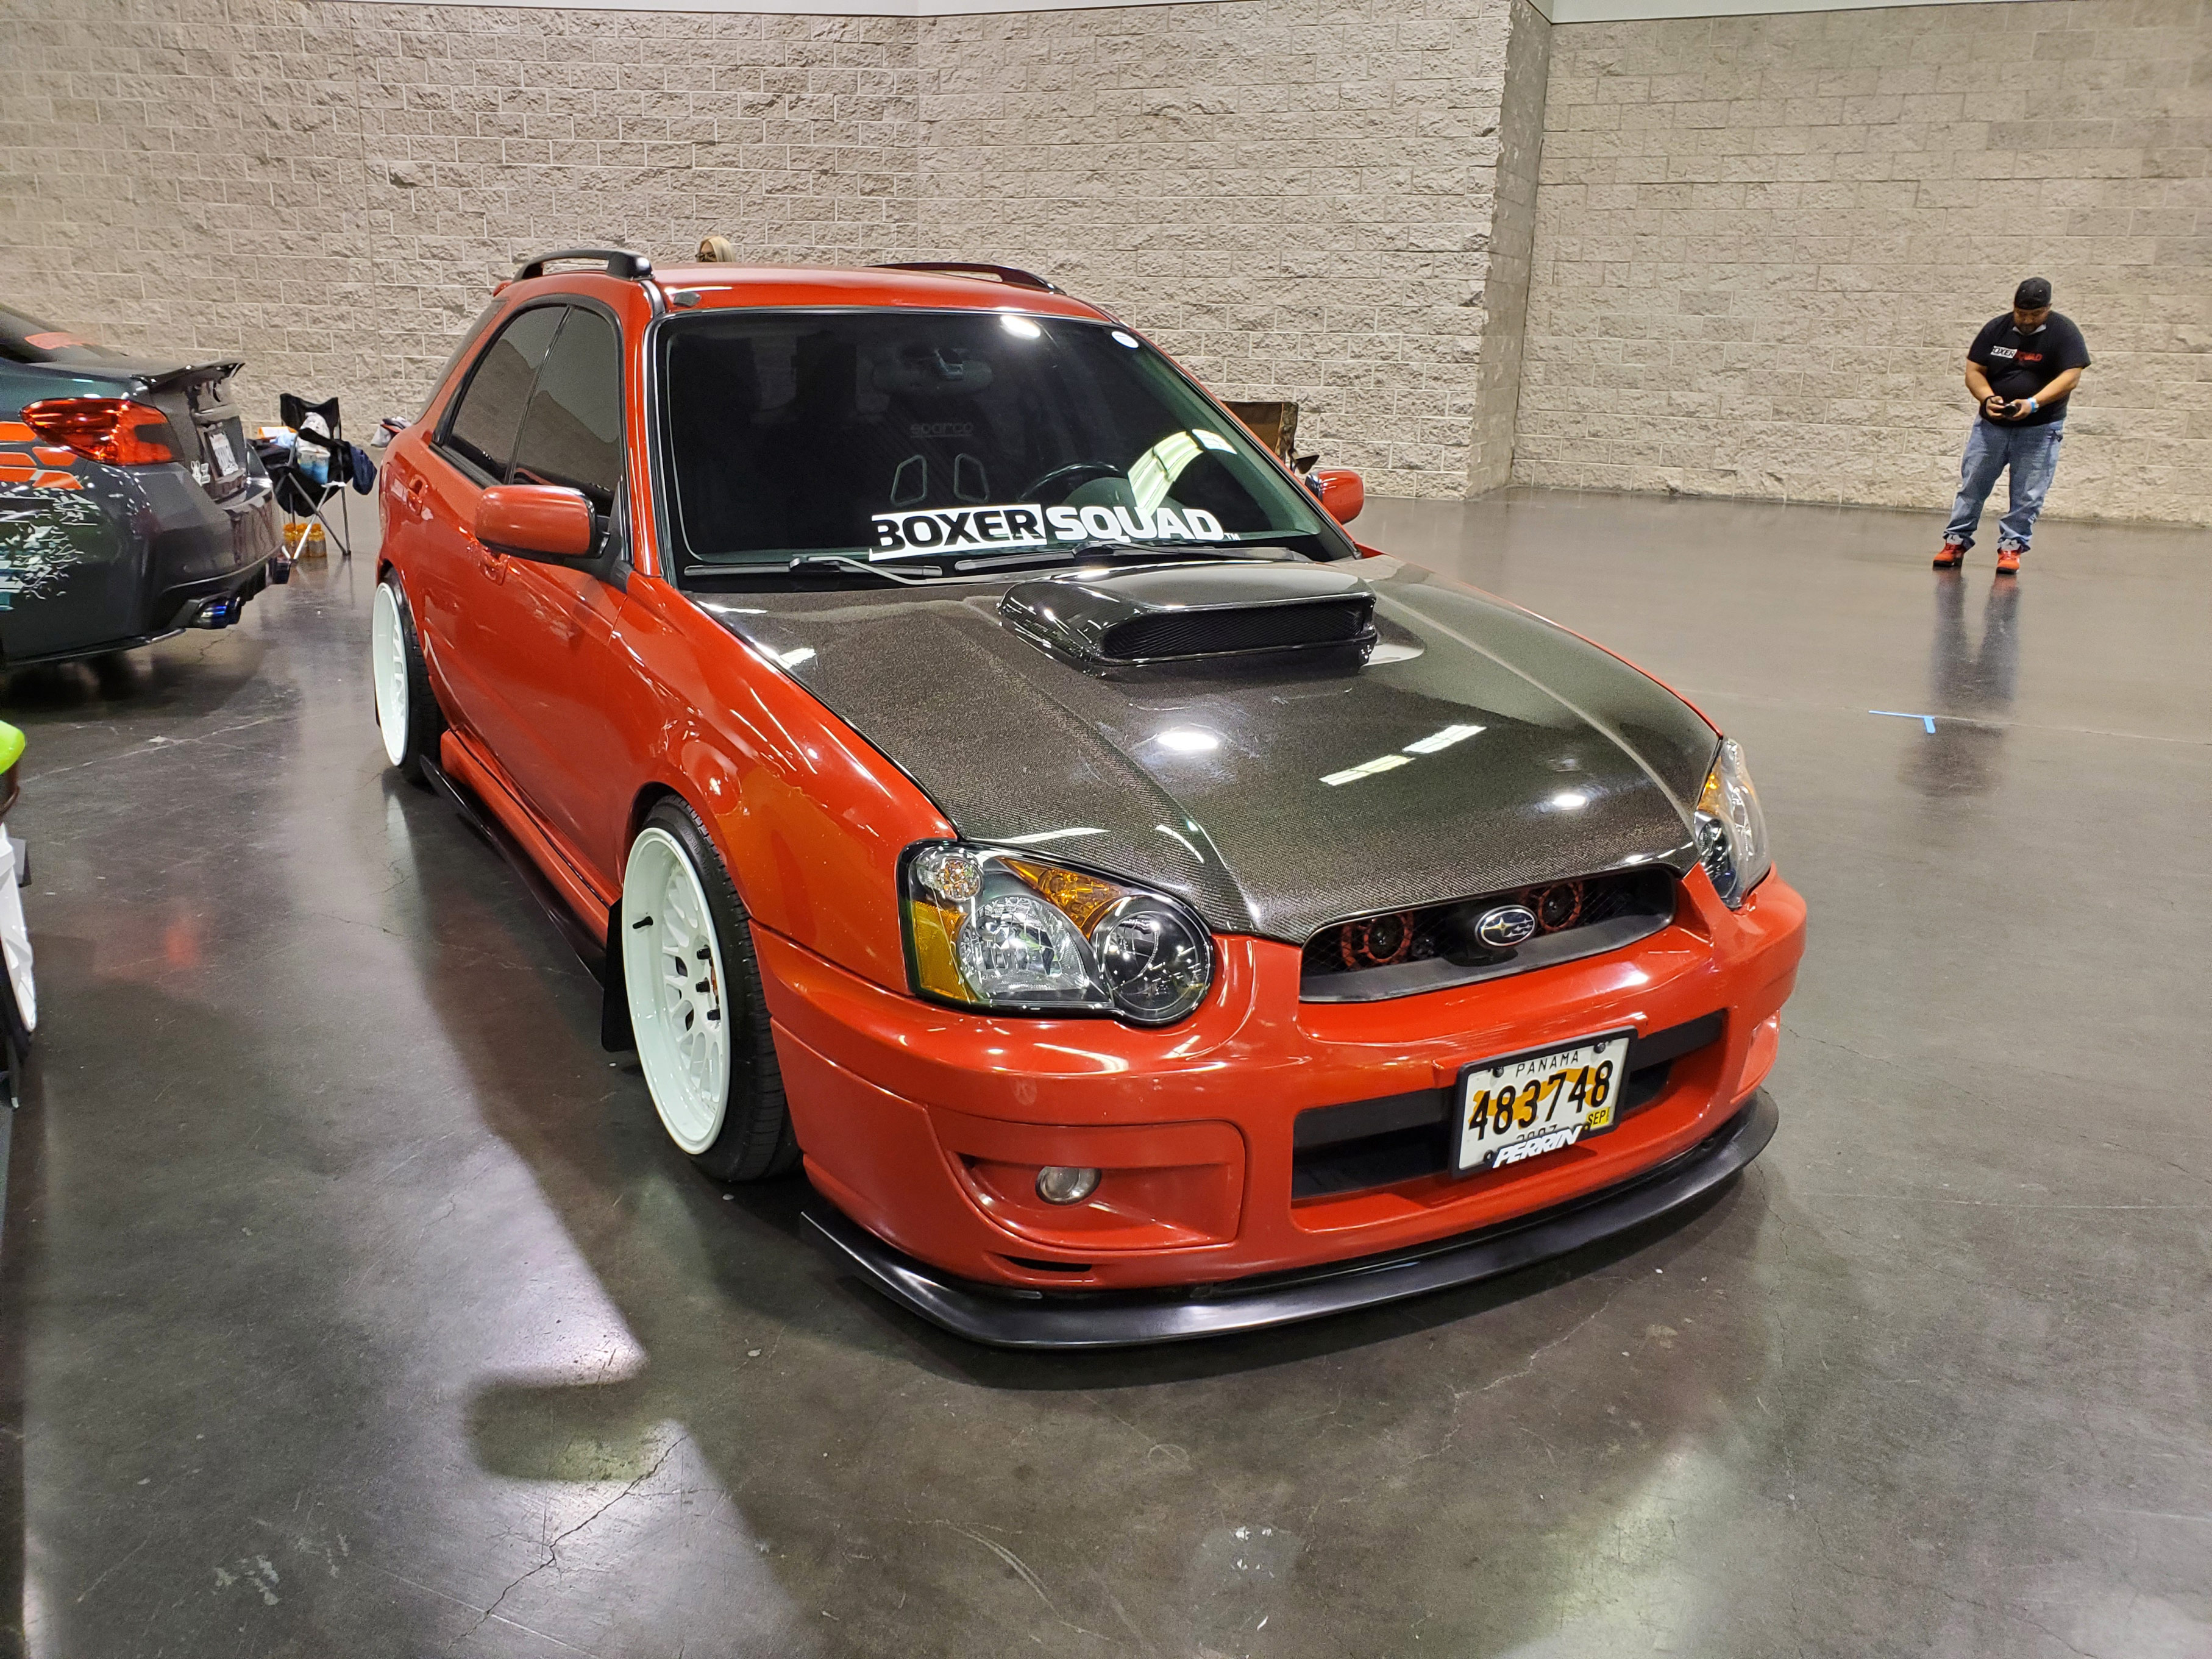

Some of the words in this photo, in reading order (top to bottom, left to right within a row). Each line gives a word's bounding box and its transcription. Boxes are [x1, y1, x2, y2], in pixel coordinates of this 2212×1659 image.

[870, 508, 1046, 556] BOXER
[1045, 505, 1225, 542] SQUAD
[1515, 1050, 1579, 1078] PANAMA
[1468, 1059, 1613, 1141] 483748
[1588, 1109, 1606, 1125] SEP
[1493, 1125, 1583, 1169] PERRIN
